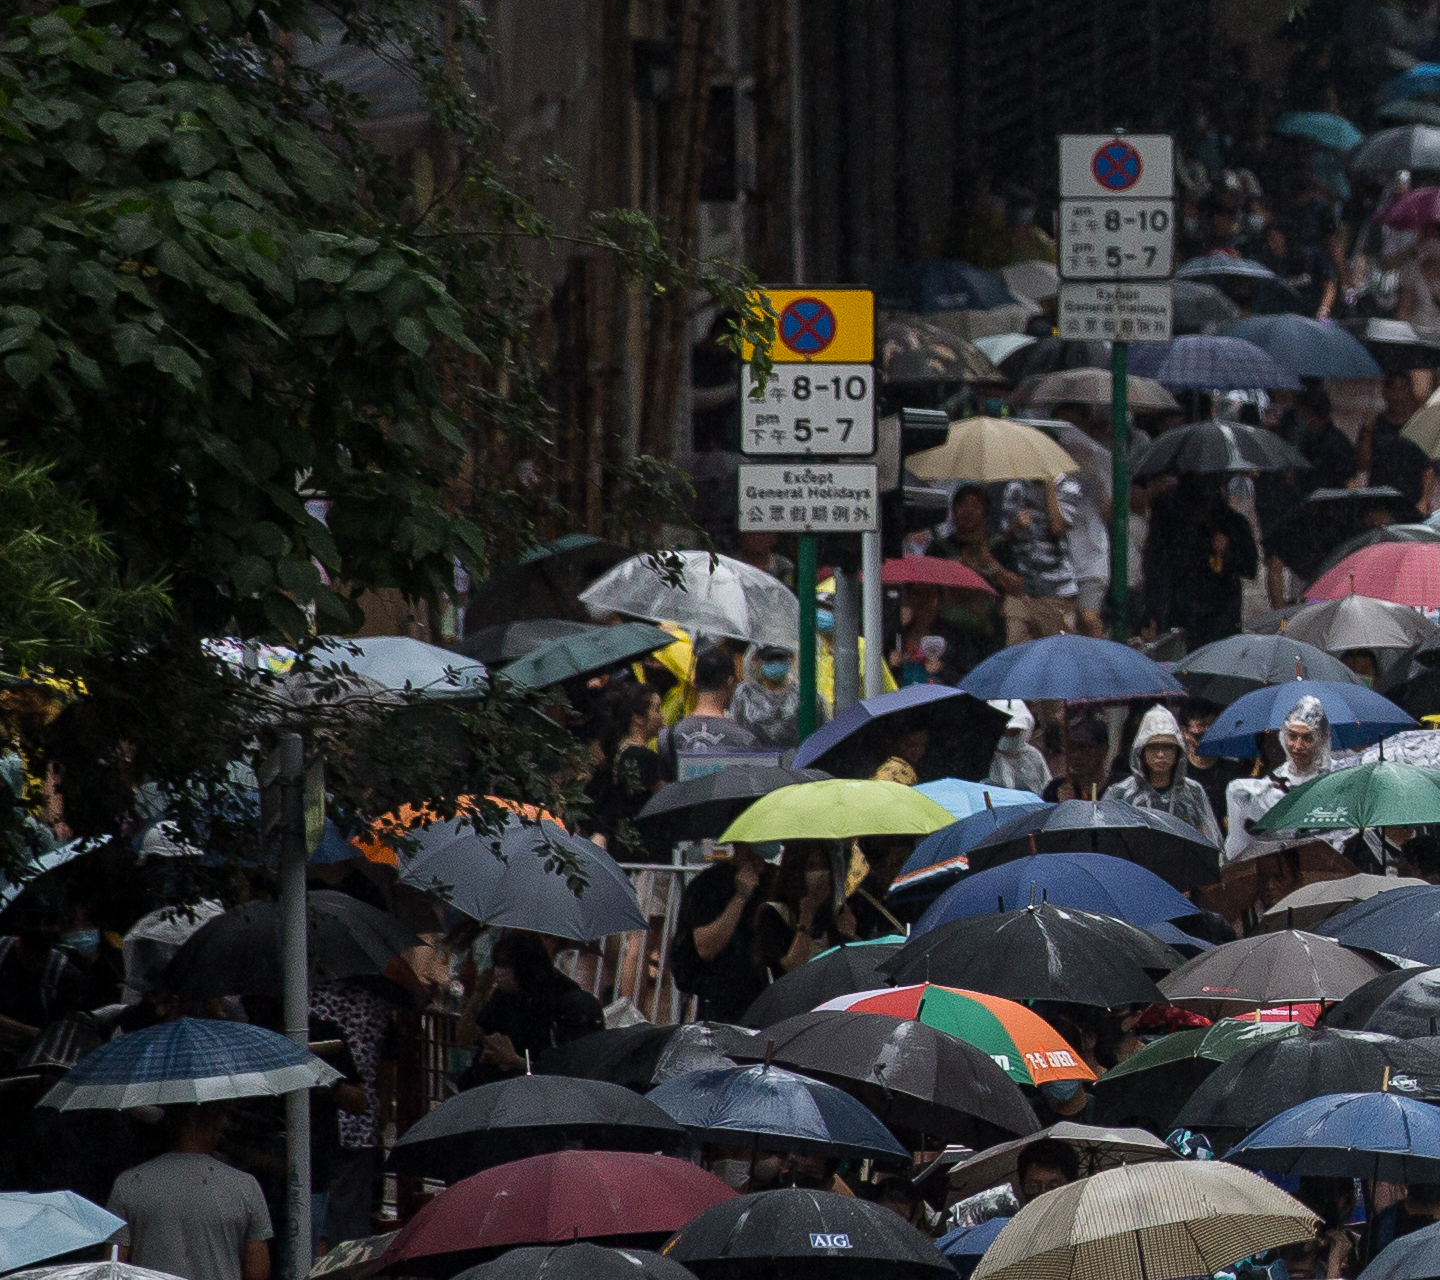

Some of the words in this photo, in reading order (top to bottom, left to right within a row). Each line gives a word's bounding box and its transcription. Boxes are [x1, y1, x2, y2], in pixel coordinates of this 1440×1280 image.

[1105, 209, 1169, 232] 8-10
[793, 375, 868, 401] 8-10
[755, 414, 780, 426] pm
[749, 428, 786, 446] 下午
[783, 471, 834, 484] Except
[745, 485, 803, 500] General
[808, 485, 871, 502] Holidays
[813, 1234, 848, 1248] AIG
